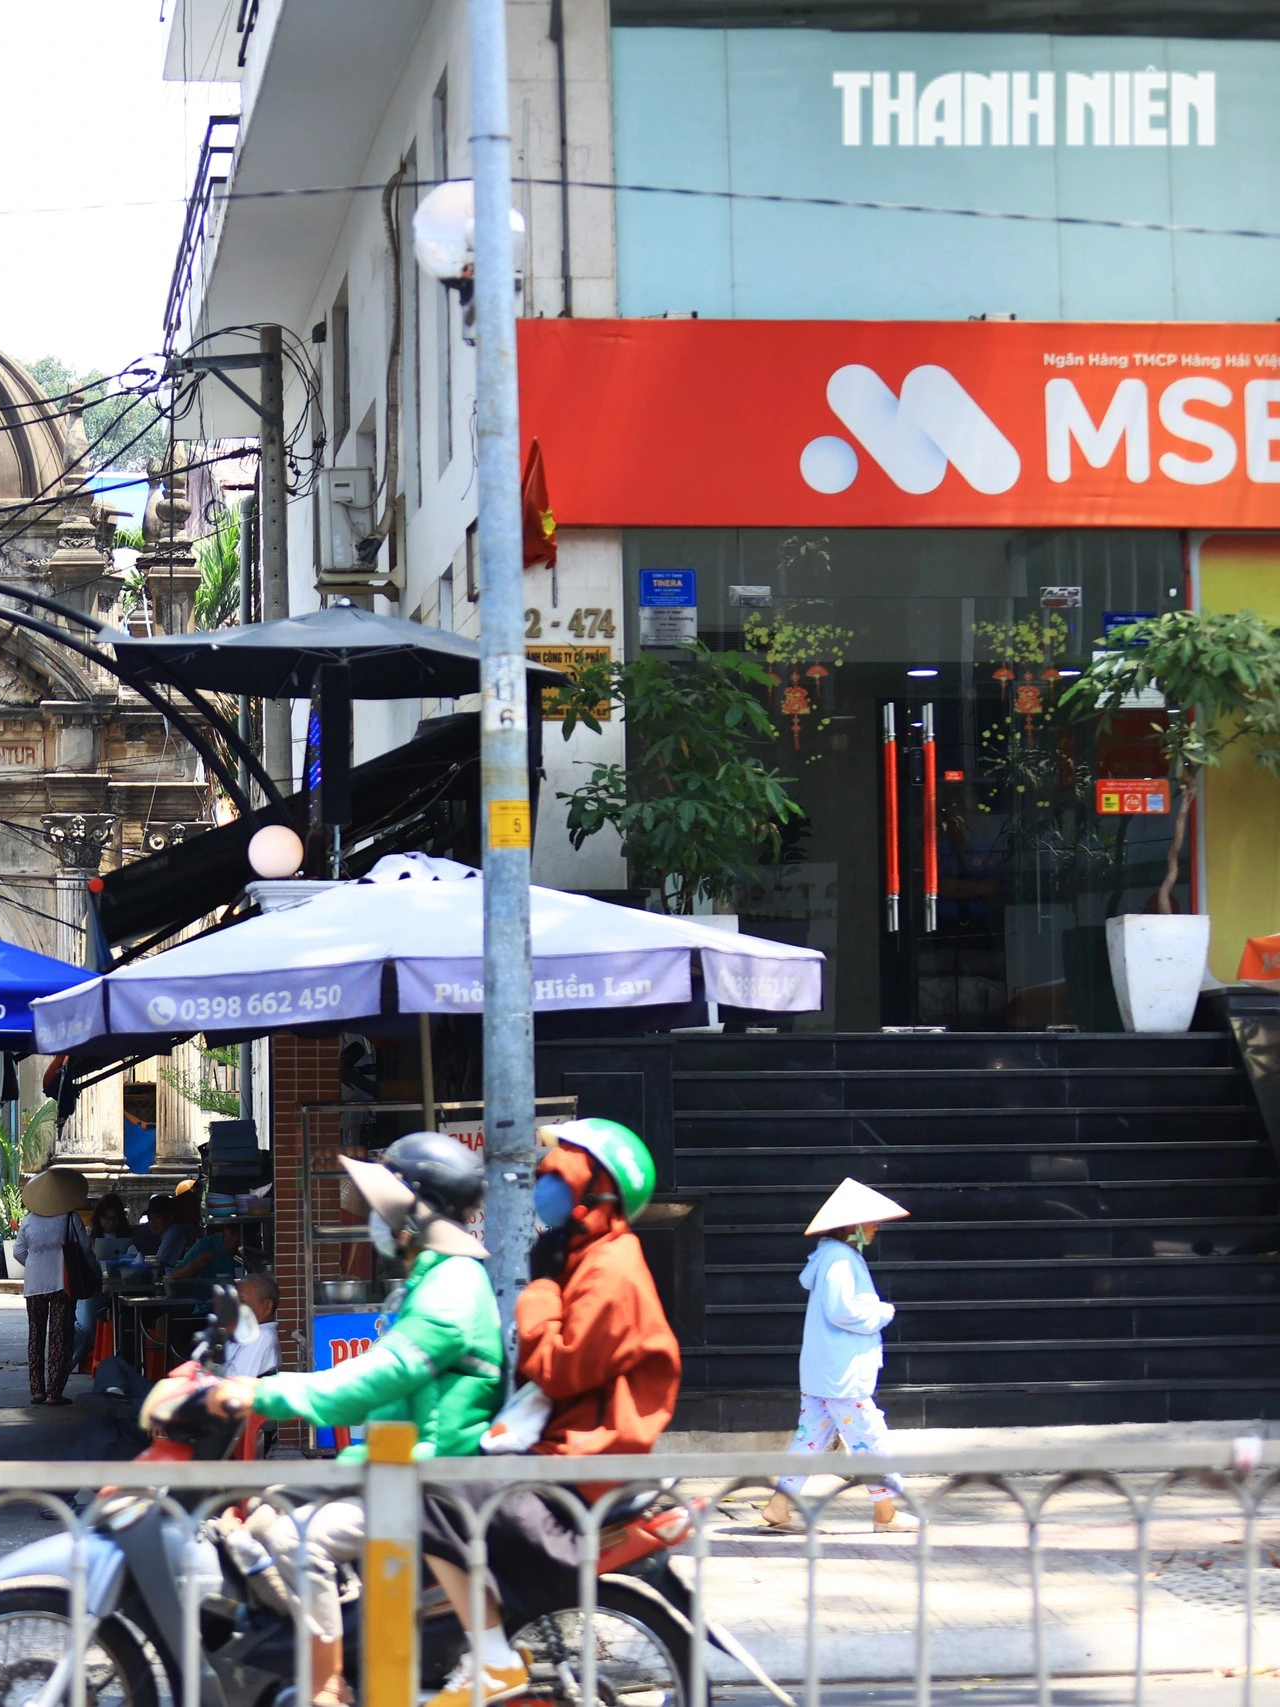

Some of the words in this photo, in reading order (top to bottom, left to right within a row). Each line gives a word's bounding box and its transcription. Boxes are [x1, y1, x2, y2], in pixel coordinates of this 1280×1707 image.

[1043, 352, 1085, 368] Ngân
[1089, 352, 1129, 368] Hàng
[1133, 354, 1177, 367] TMCP
[1181, 353, 1221, 369] Hàng
[568, 608, 616, 638] 474
[564, 652, 573, 663] TY
[534, 973, 595, 1000] Hiền
[603, 976, 652, 998] Lan
[180, 995, 242, 1021] 0398
[247, 990, 293, 1016] 662
[299, 984, 342, 1008] 450
